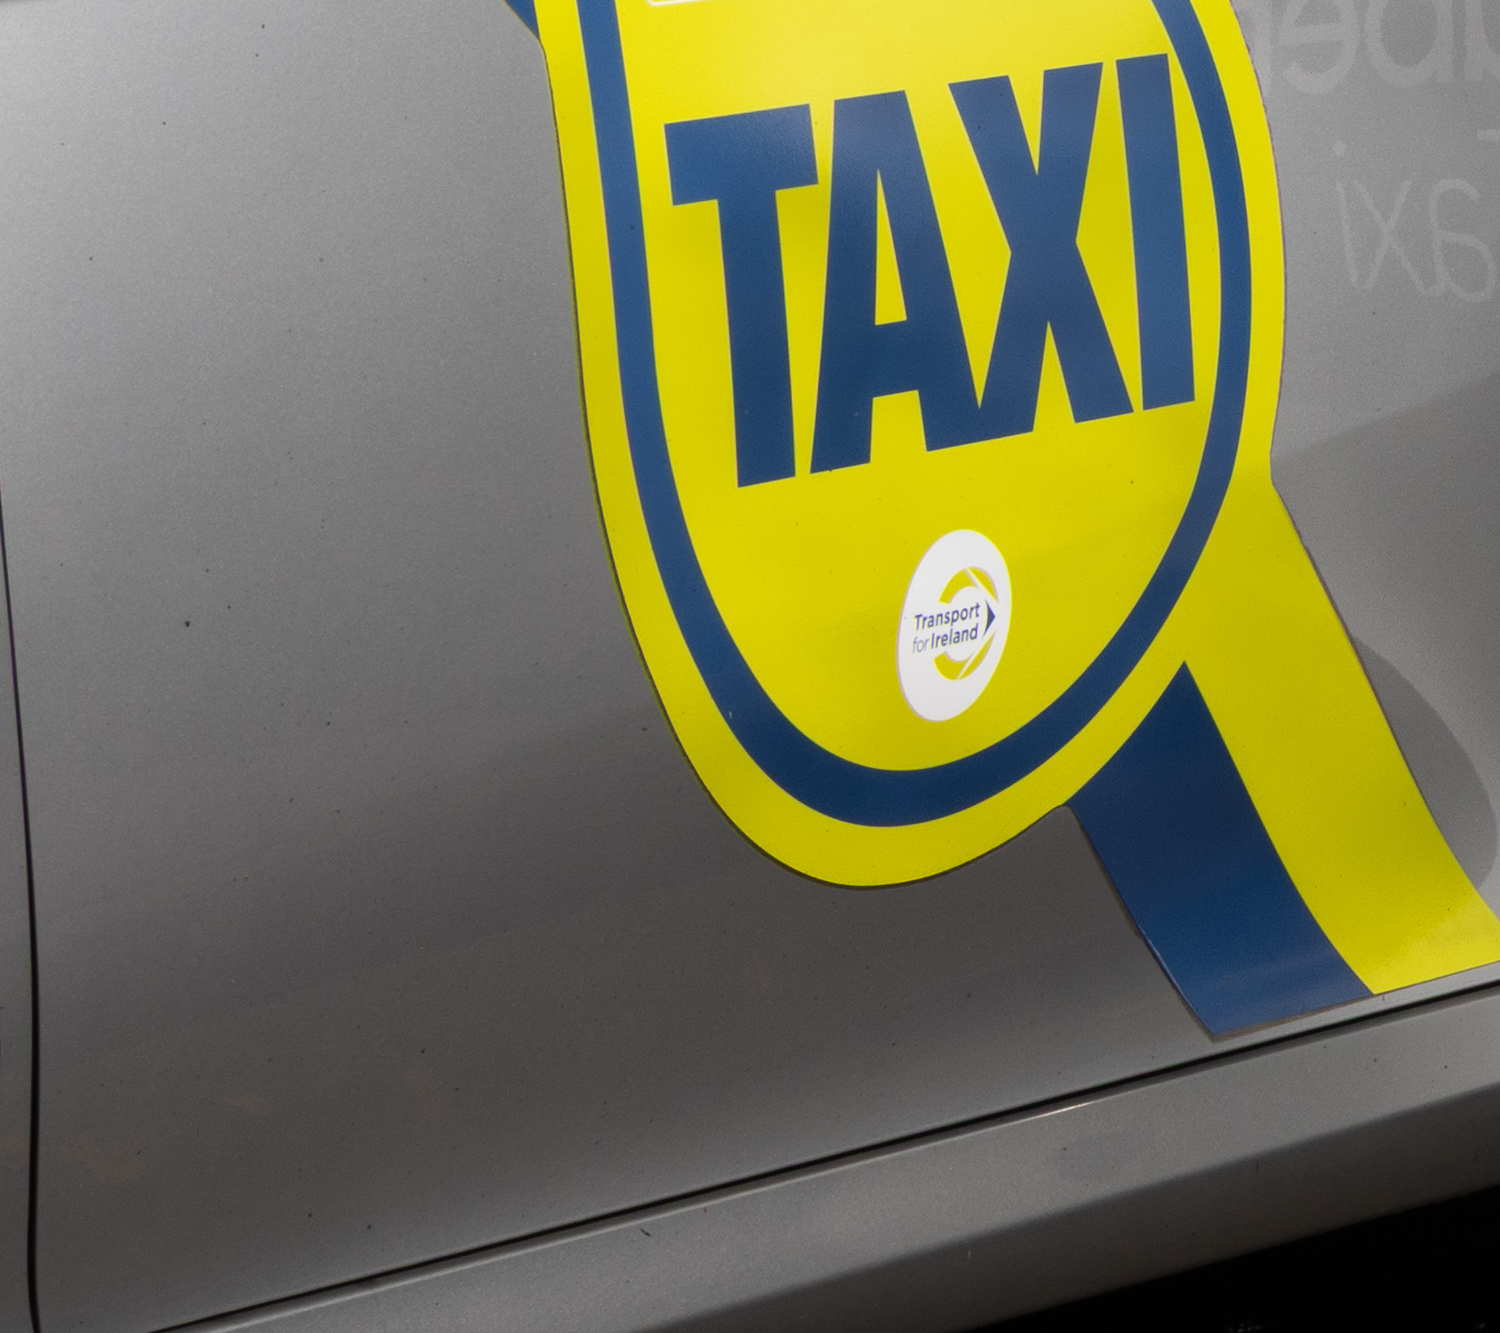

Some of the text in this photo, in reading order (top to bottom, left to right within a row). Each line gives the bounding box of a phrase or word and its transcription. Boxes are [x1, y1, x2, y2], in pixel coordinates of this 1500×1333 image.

[664, 53, 1194, 486] TAXI
[914, 602, 980, 631] Transport
[912, 623, 979, 653] for Ireland
